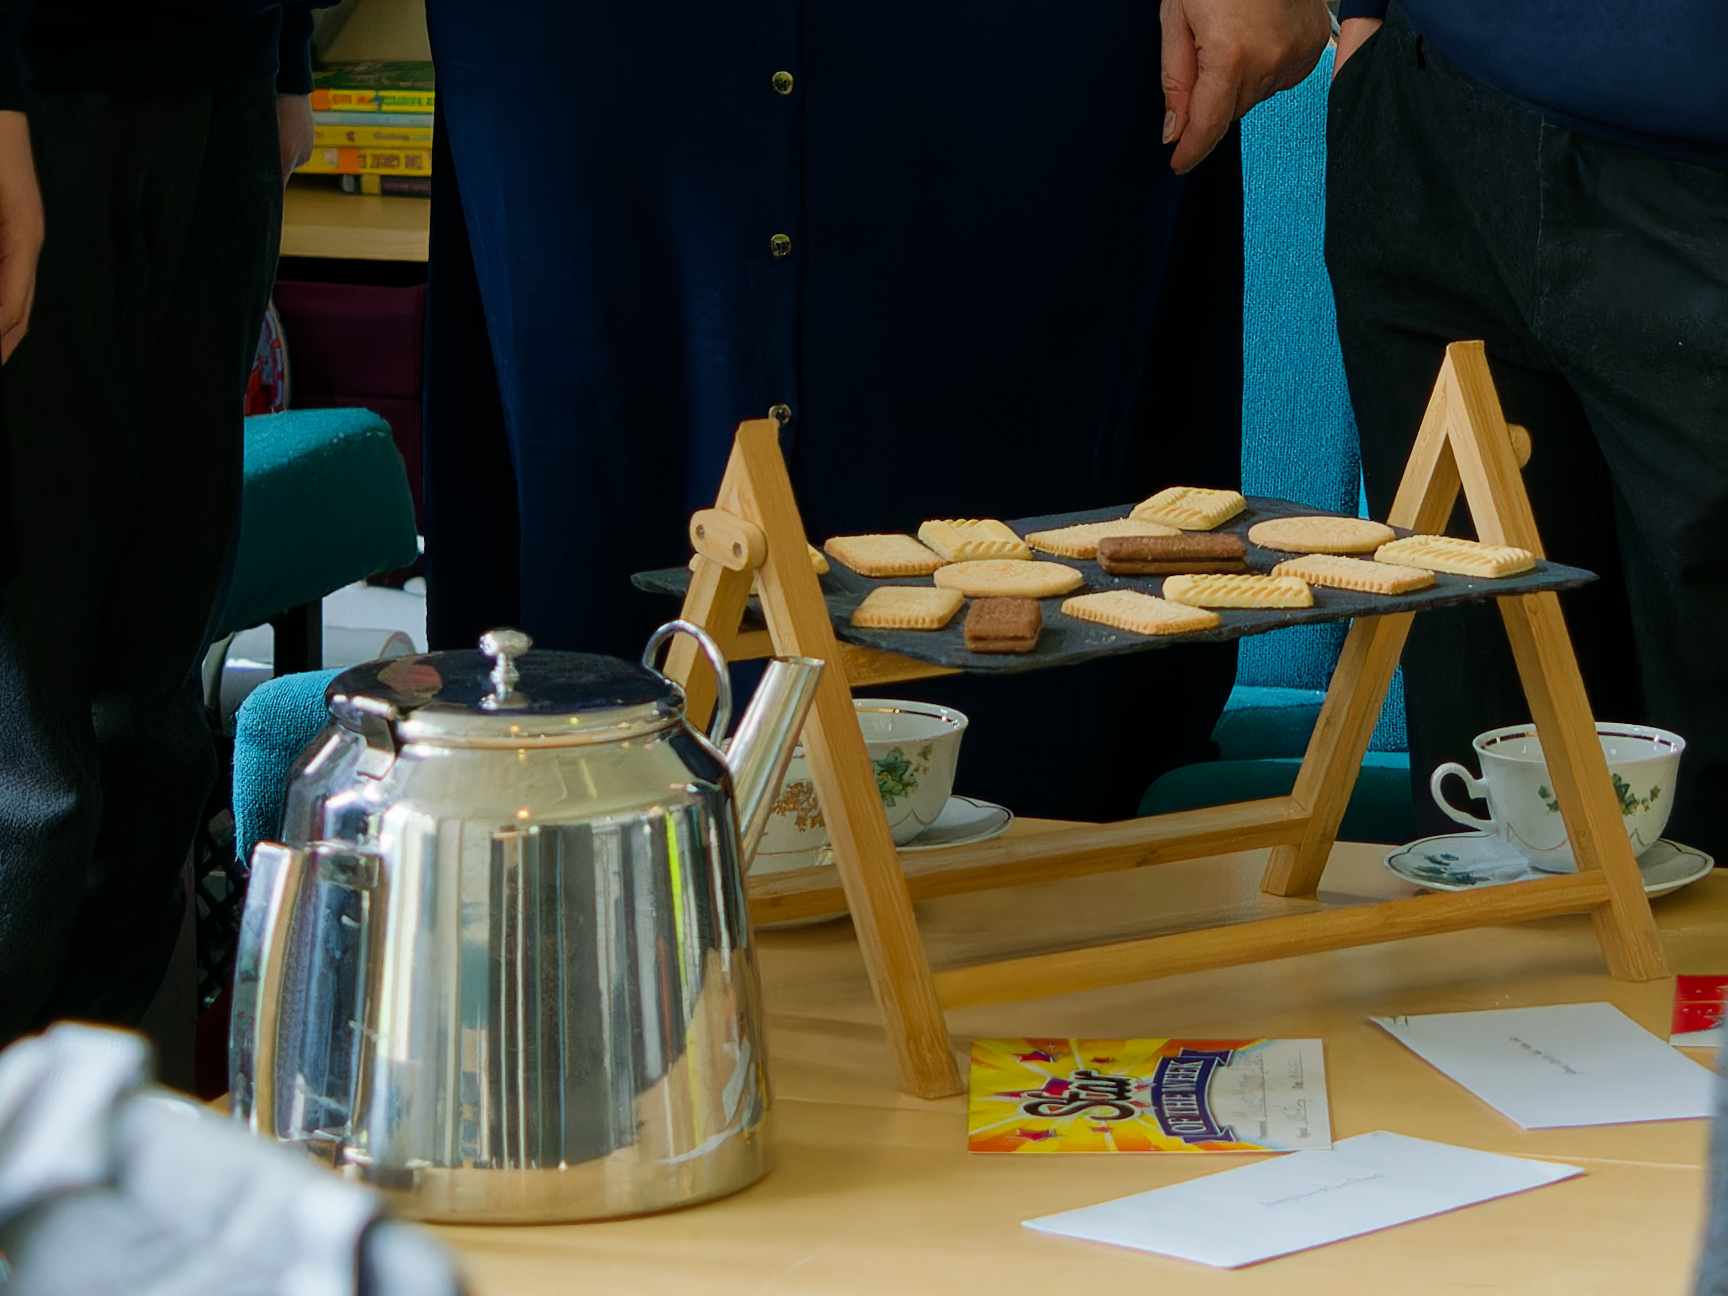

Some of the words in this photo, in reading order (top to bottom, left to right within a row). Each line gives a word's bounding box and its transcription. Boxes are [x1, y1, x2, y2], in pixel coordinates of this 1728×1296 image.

[1161, 1059, 1204, 1092] WEEK
[1021, 1068, 1139, 1122] Star
[1162, 1093, 1201, 1118] THE
[1166, 1117, 1207, 1133] OF
